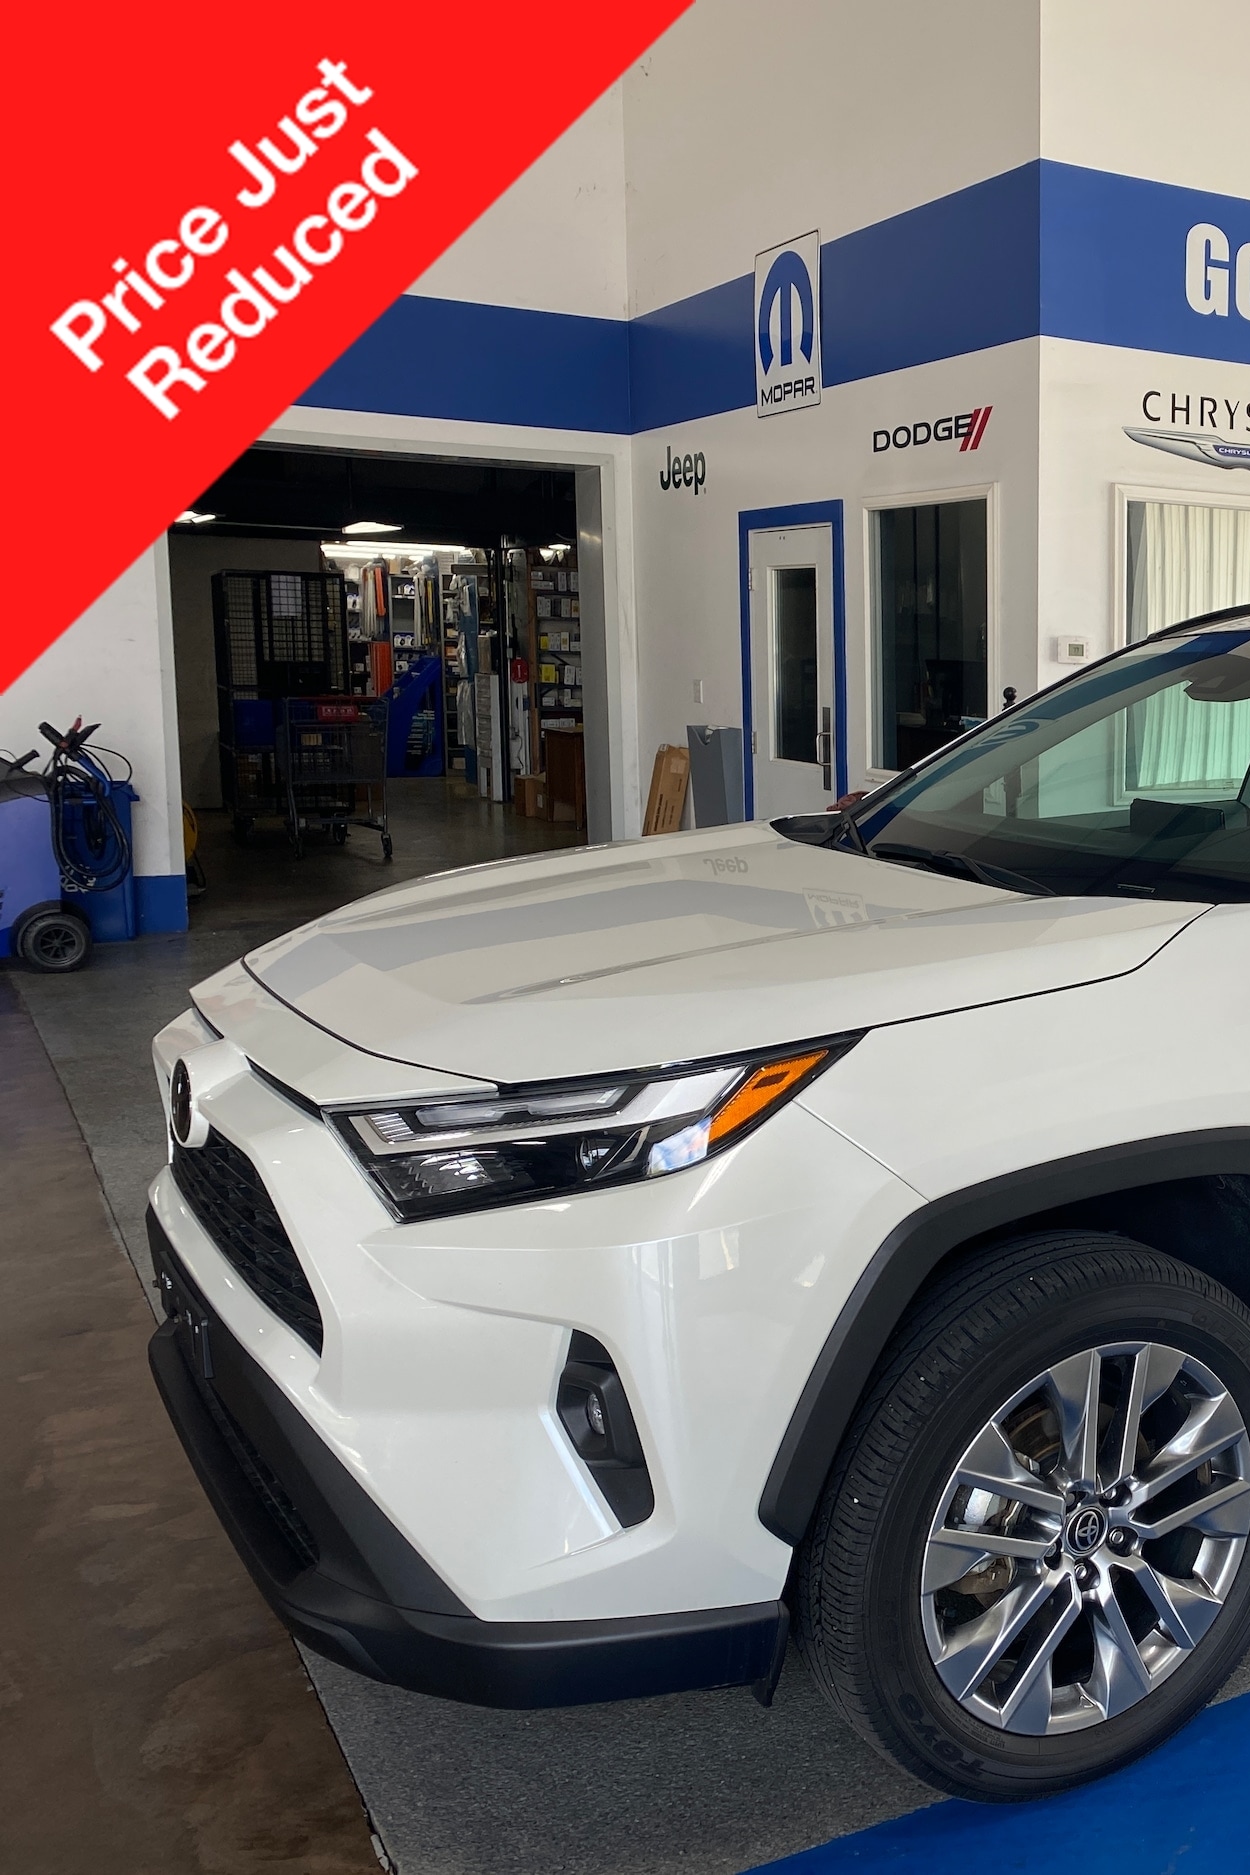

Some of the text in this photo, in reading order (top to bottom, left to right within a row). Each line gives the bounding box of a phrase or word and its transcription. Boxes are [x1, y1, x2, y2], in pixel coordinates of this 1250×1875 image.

[760, 376, 816, 407] MOPAR
[872, 413, 974, 453] DODGE
[659, 446, 706, 495] Jeep
